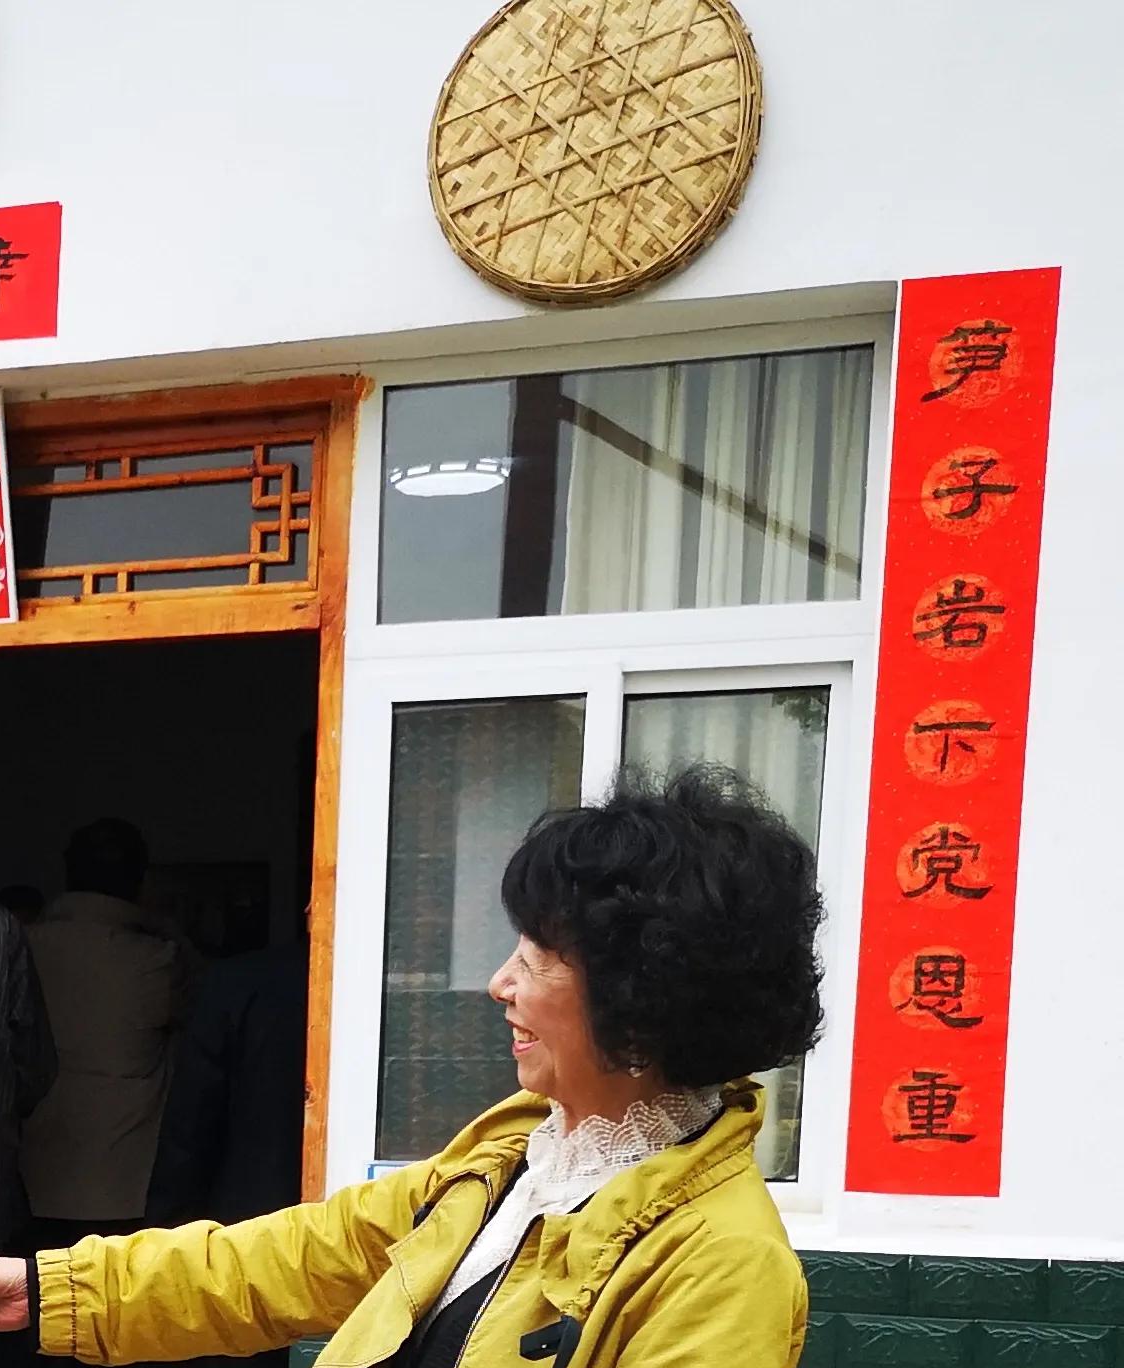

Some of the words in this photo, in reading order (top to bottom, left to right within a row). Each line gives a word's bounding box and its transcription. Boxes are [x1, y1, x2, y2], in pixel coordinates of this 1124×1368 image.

[892, 319, 1020, 1143] 笋子岩下党恩重
